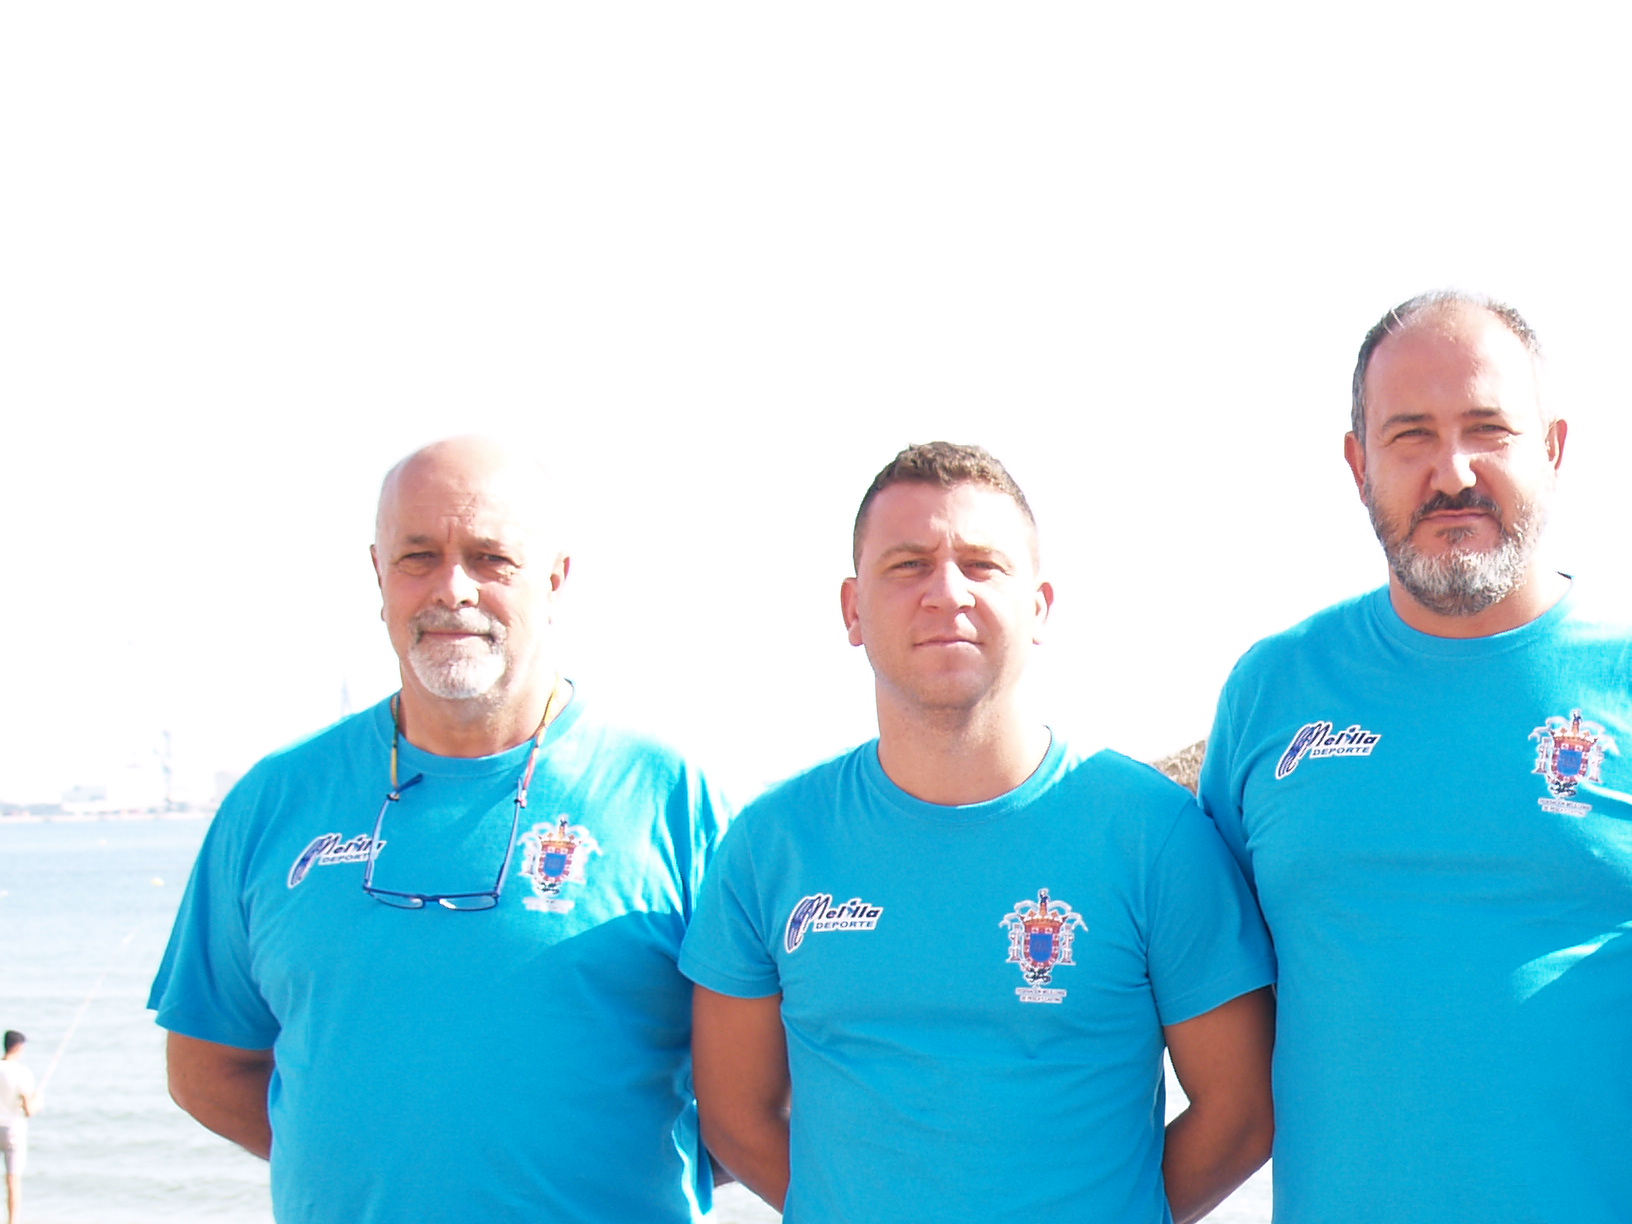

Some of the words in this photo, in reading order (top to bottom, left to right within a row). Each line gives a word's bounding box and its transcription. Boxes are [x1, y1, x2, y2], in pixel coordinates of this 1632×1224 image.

[1277, 722, 1379, 778] Melilla
[1312, 746, 1370, 757] DEPORTE
[321, 853, 371, 863] DEPORT
[786, 894, 881, 952] Melilla
[815, 920, 874, 930] DEPORTE
